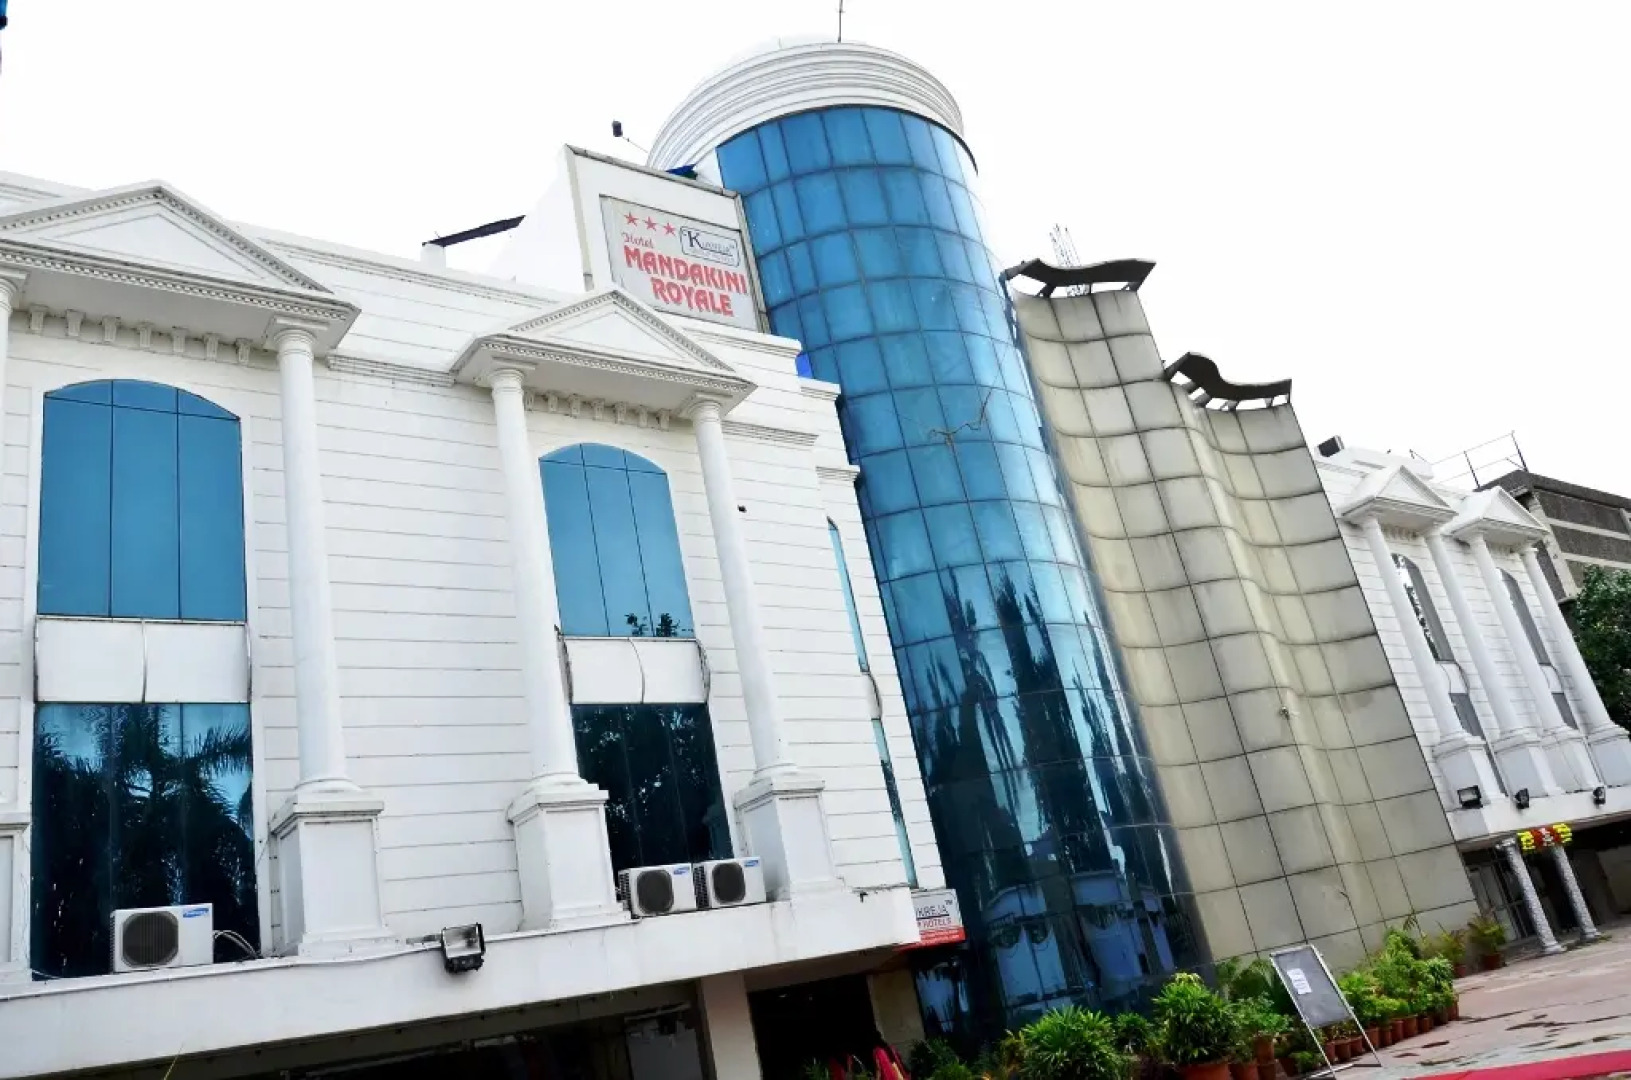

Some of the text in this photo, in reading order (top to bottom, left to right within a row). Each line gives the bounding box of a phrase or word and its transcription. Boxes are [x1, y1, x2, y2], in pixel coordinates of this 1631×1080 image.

[622, 233, 653, 249] Hotel
[624, 245, 748, 294] MANDAKINI
[651, 277, 734, 317] ROYALE
[923, 918, 952, 928] HOTELS
